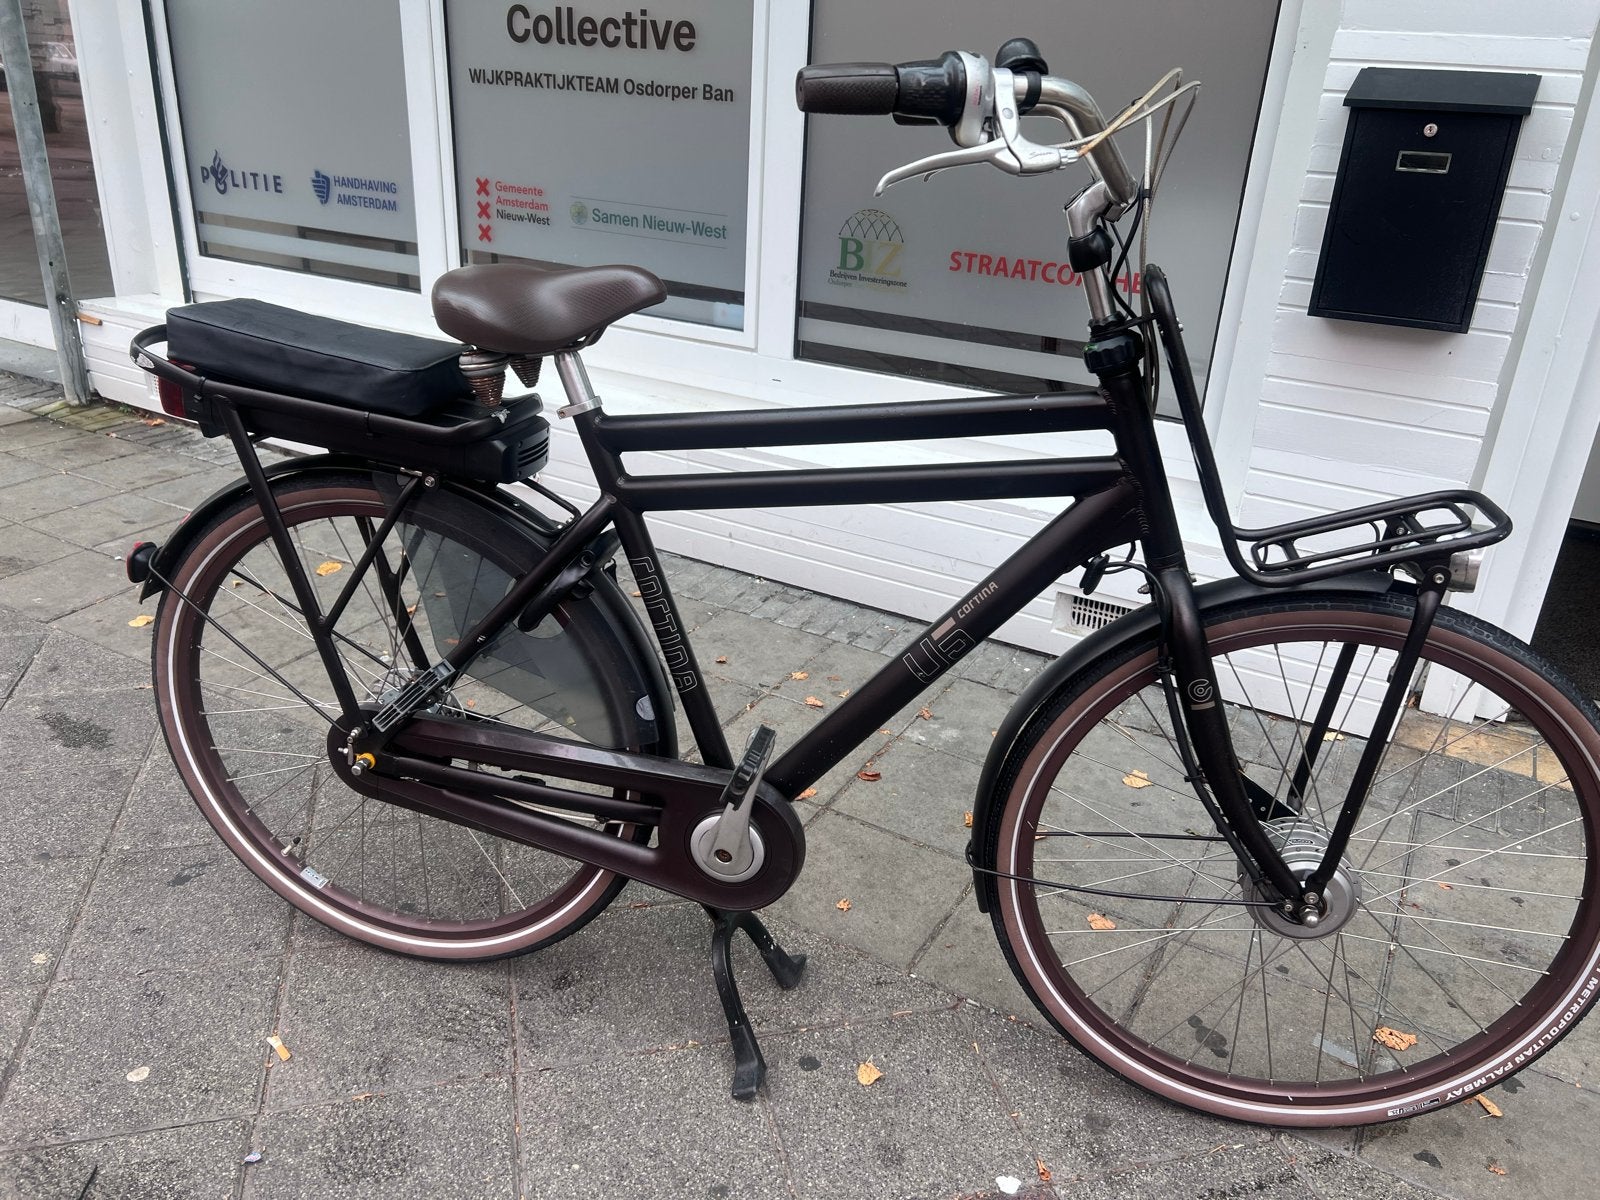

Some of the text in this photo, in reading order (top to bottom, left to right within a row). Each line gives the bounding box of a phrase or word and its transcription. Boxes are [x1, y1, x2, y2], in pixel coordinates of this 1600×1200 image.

[506, 4, 696, 51] Collective
[468, 68, 734, 102] WIJKPRAKTIJKTEAM Osdorper Ban
[333, 175, 397, 194] HANDHAVING
[495, 181, 544, 197] Gemeente
[336, 194, 397, 212] AMSTERDAM
[495, 195, 549, 211] Amsterdam
[496, 209, 551, 226] Nieuw-West
[591, 208, 727, 240] Samen Nieuw-West
[837, 237, 903, 277] BIZ
[1445, 976, 1599, 1101] METROPOLITAN PALMBAY
